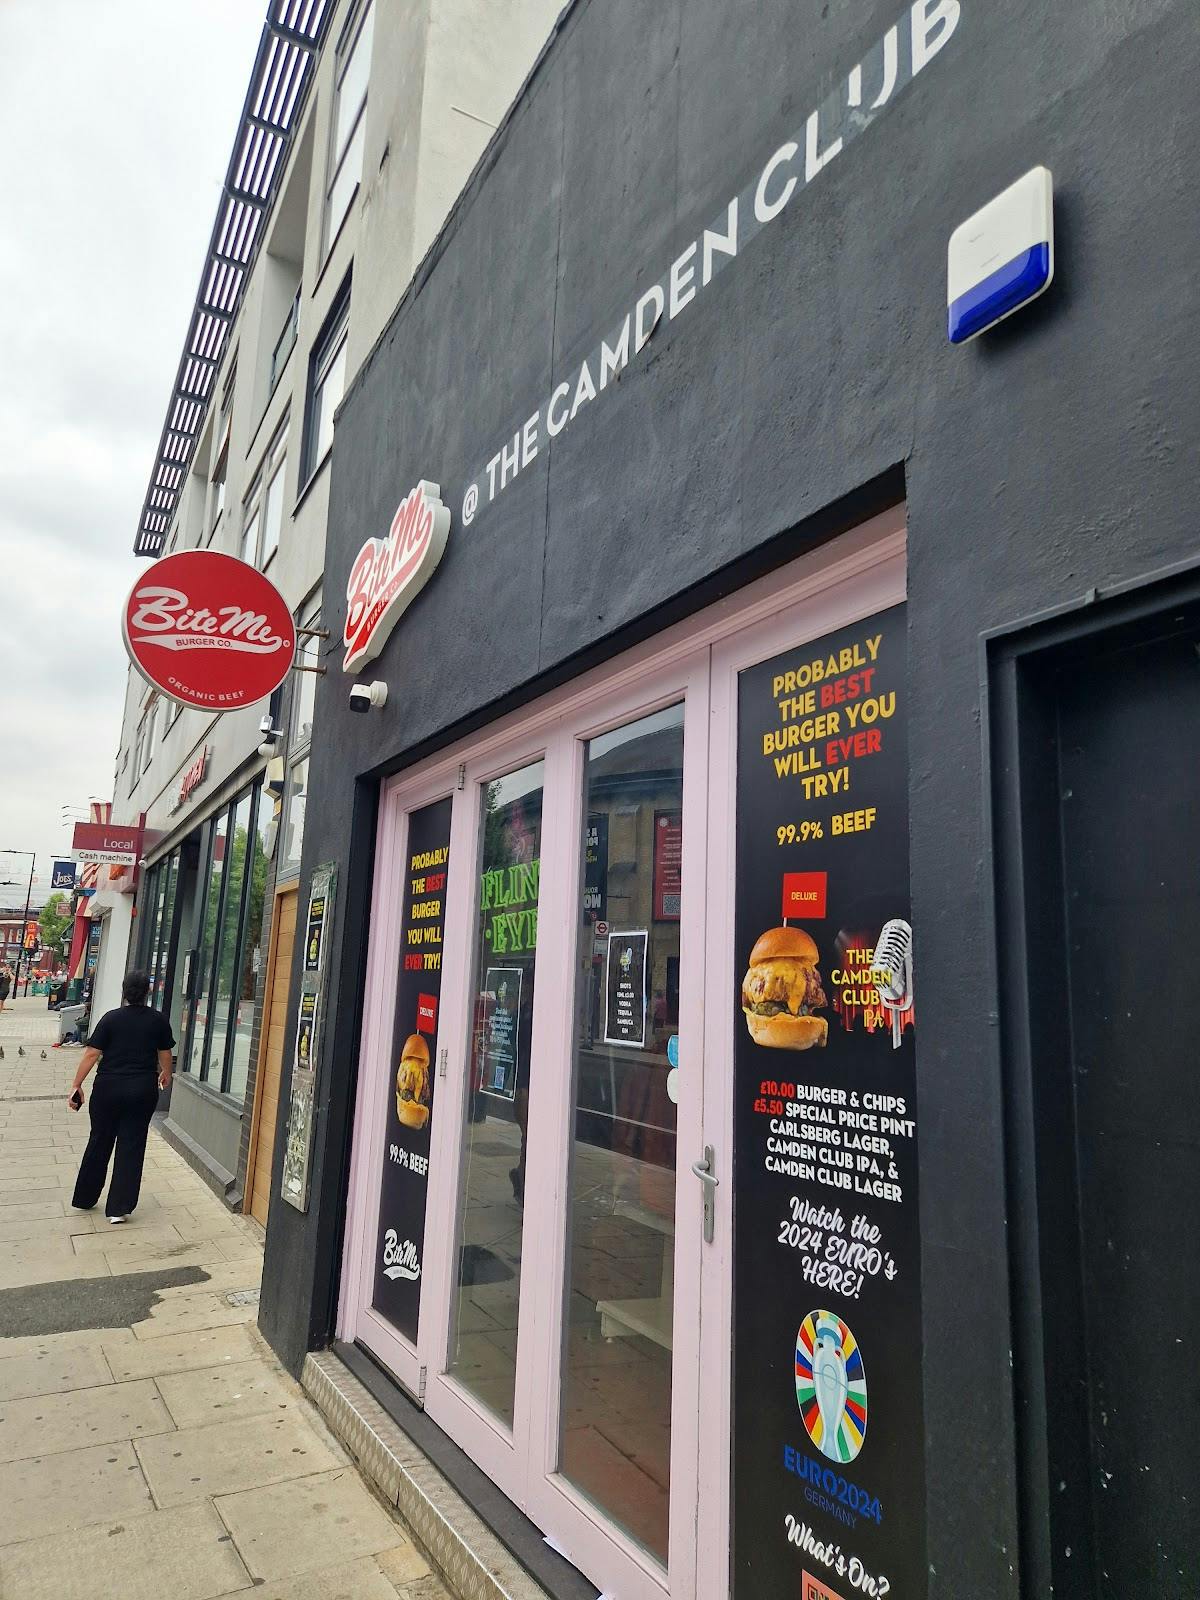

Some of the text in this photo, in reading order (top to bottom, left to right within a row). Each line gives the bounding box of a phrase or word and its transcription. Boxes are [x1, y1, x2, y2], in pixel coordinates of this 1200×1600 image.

[486, 411, 540, 501] THE
[547, 197, 739, 437] CAMDEN
[754, 0, 960, 222] CLUB
[131, 586, 282, 645] Bite Me
[175, 638, 233, 648] BURGER CO.
[772, 634, 882, 698] PROBABLY
[168, 677, 245, 701] ORGANIC BEEF
[778, 668, 875, 722] THE BEST
[763, 691, 896, 755] BURGER YOU
[774, 728, 882, 779] WILL EVER
[801, 766, 849, 800] TRY!
[103, 838, 134, 849] Local
[776, 807, 877, 845] 99.9% BEEF
[79, 851, 133, 862] Cash machine
[411, 847, 449, 871] PROBABLY
[411, 873, 446, 895] THE BEST
[791, 892, 818, 900] DELUXE
[411, 900, 441, 919] BURGER
[407, 926, 442, 944] YOU WILL
[404, 953, 442, 970] EVER TRY!
[846, 949, 874, 965] THE
[831, 969, 892, 985] CAMDEN
[842, 990, 880, 1005] CLUB
[760, 1080, 907, 1115] £10.00 BURGER & CHIPS
[753, 1098, 916, 1138] £5.50 SPECIAL PRICE PINT
[769, 1119, 894, 1159] CARLSBERG LAGER,
[389, 1143, 429, 1176] 99.9% BEEF
[766, 1137, 899, 1180] CAMDEN CLUB IPA, &
[764, 1156, 903, 1203] CAMDEN CLUB LAGER
[789, 1196, 882, 1244] Watch the
[777, 1220, 898, 1281] 2024 EURO's
[801, 1255, 864, 1299] HERE!
[783, 1444, 883, 1526] EURO2024
[803, 1487, 857, 1529] GERMANY
[784, 1514, 891, 1600] What's On?
